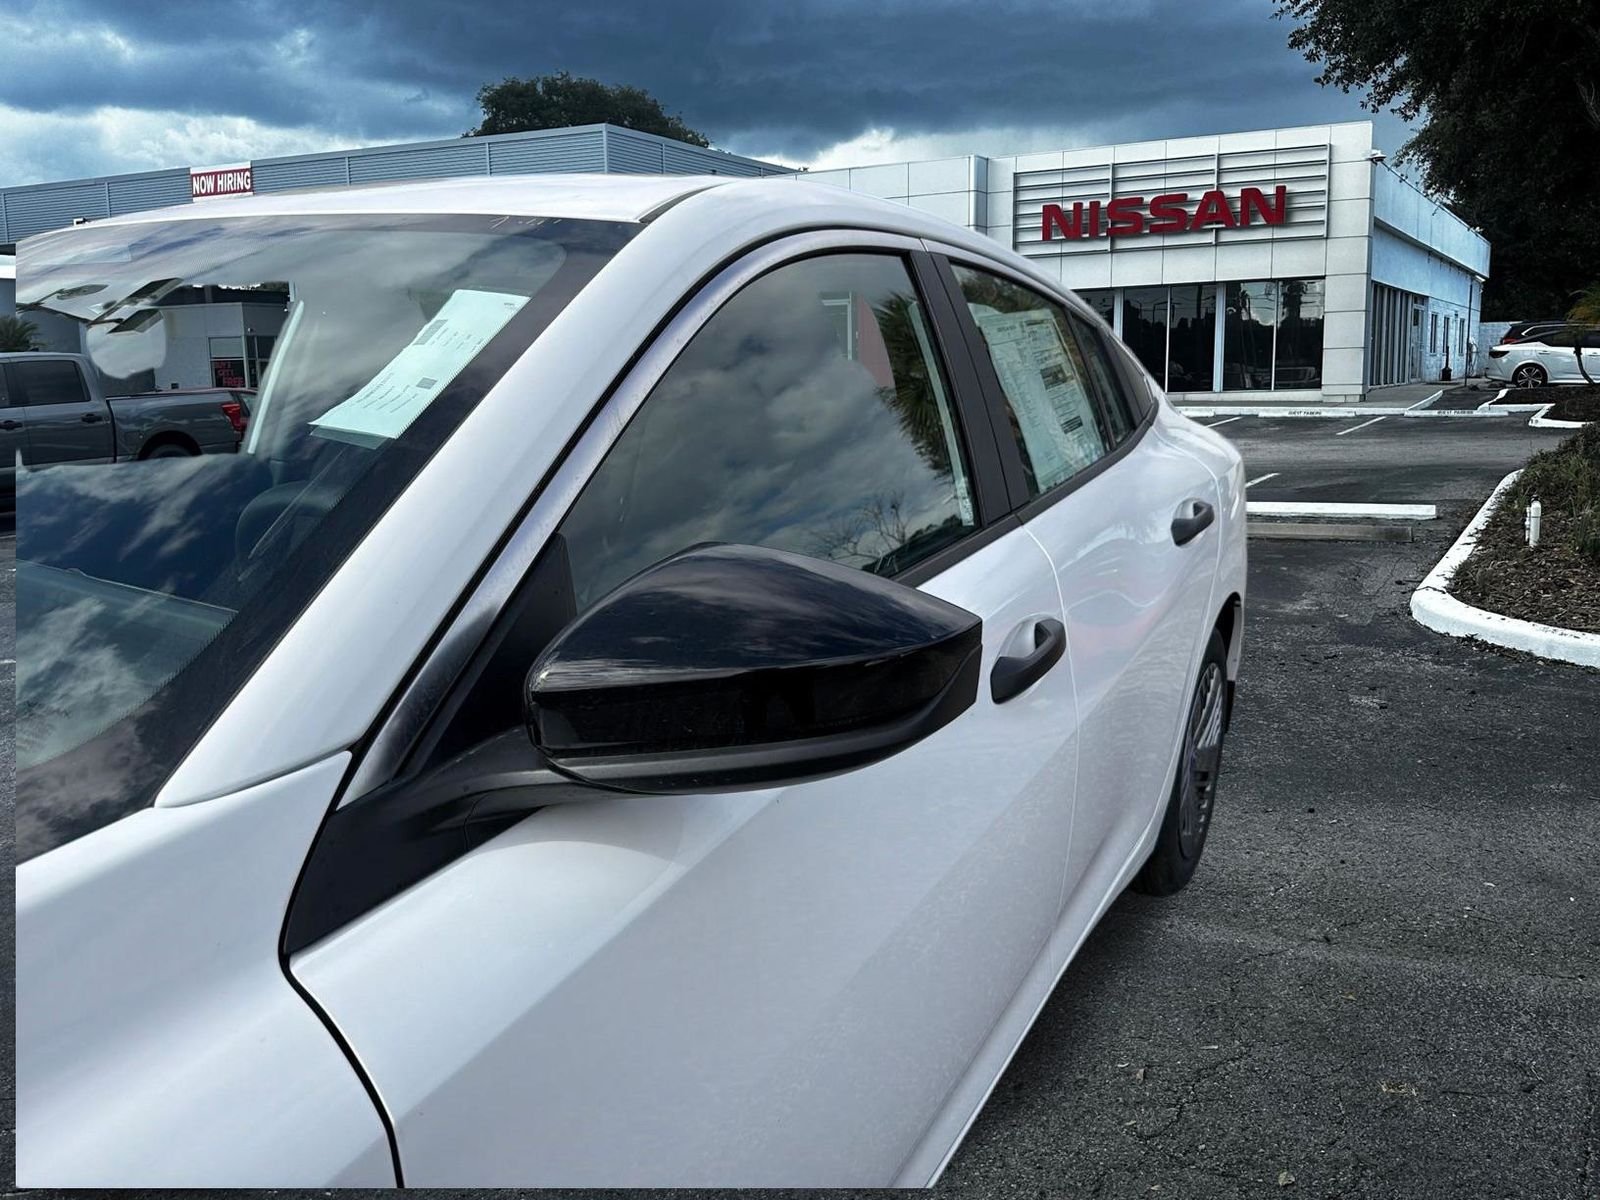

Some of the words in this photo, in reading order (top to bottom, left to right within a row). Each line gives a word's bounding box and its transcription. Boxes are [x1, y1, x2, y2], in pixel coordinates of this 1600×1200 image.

[192, 175, 215, 195] NOW
[217, 171, 251, 192] HIRING
[1042, 185, 1287, 241] NISSAN
